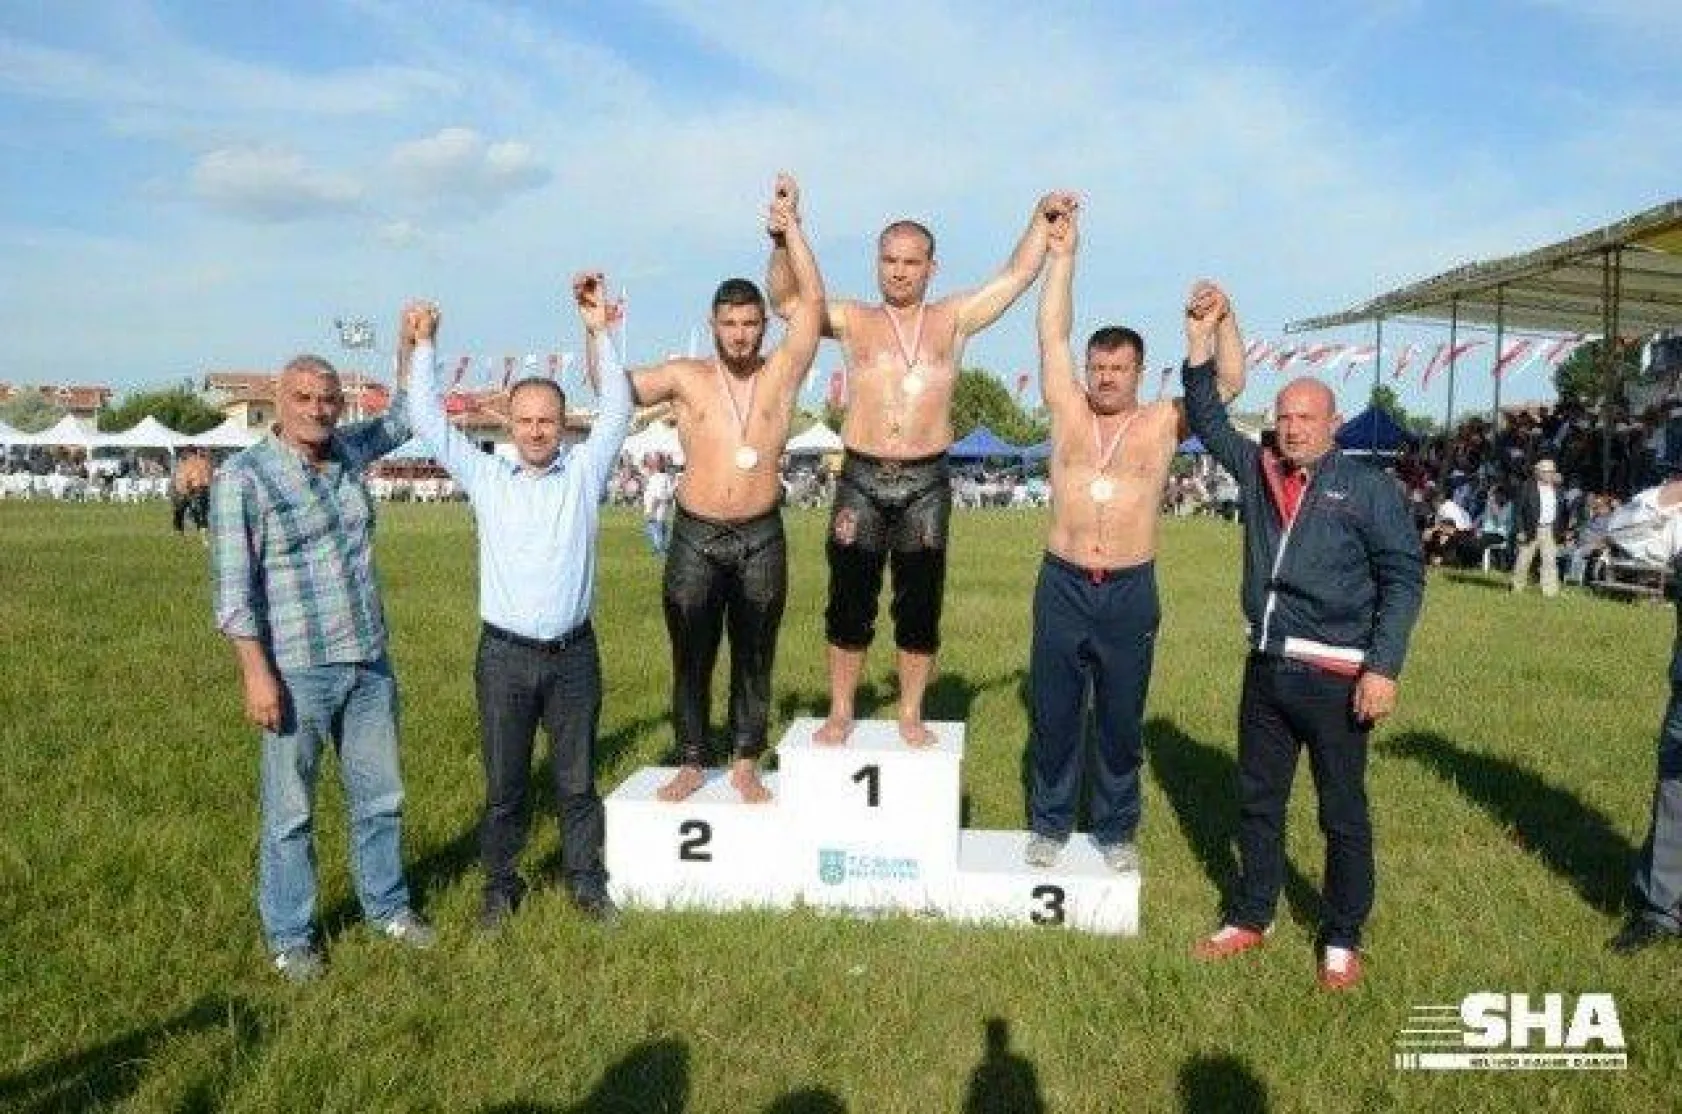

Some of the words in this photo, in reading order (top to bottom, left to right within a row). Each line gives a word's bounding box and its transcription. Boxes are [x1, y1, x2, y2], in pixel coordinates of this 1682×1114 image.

[851, 764, 880, 807] 1
[679, 819, 712, 862] 2
[1031, 884, 1065, 926] 3
